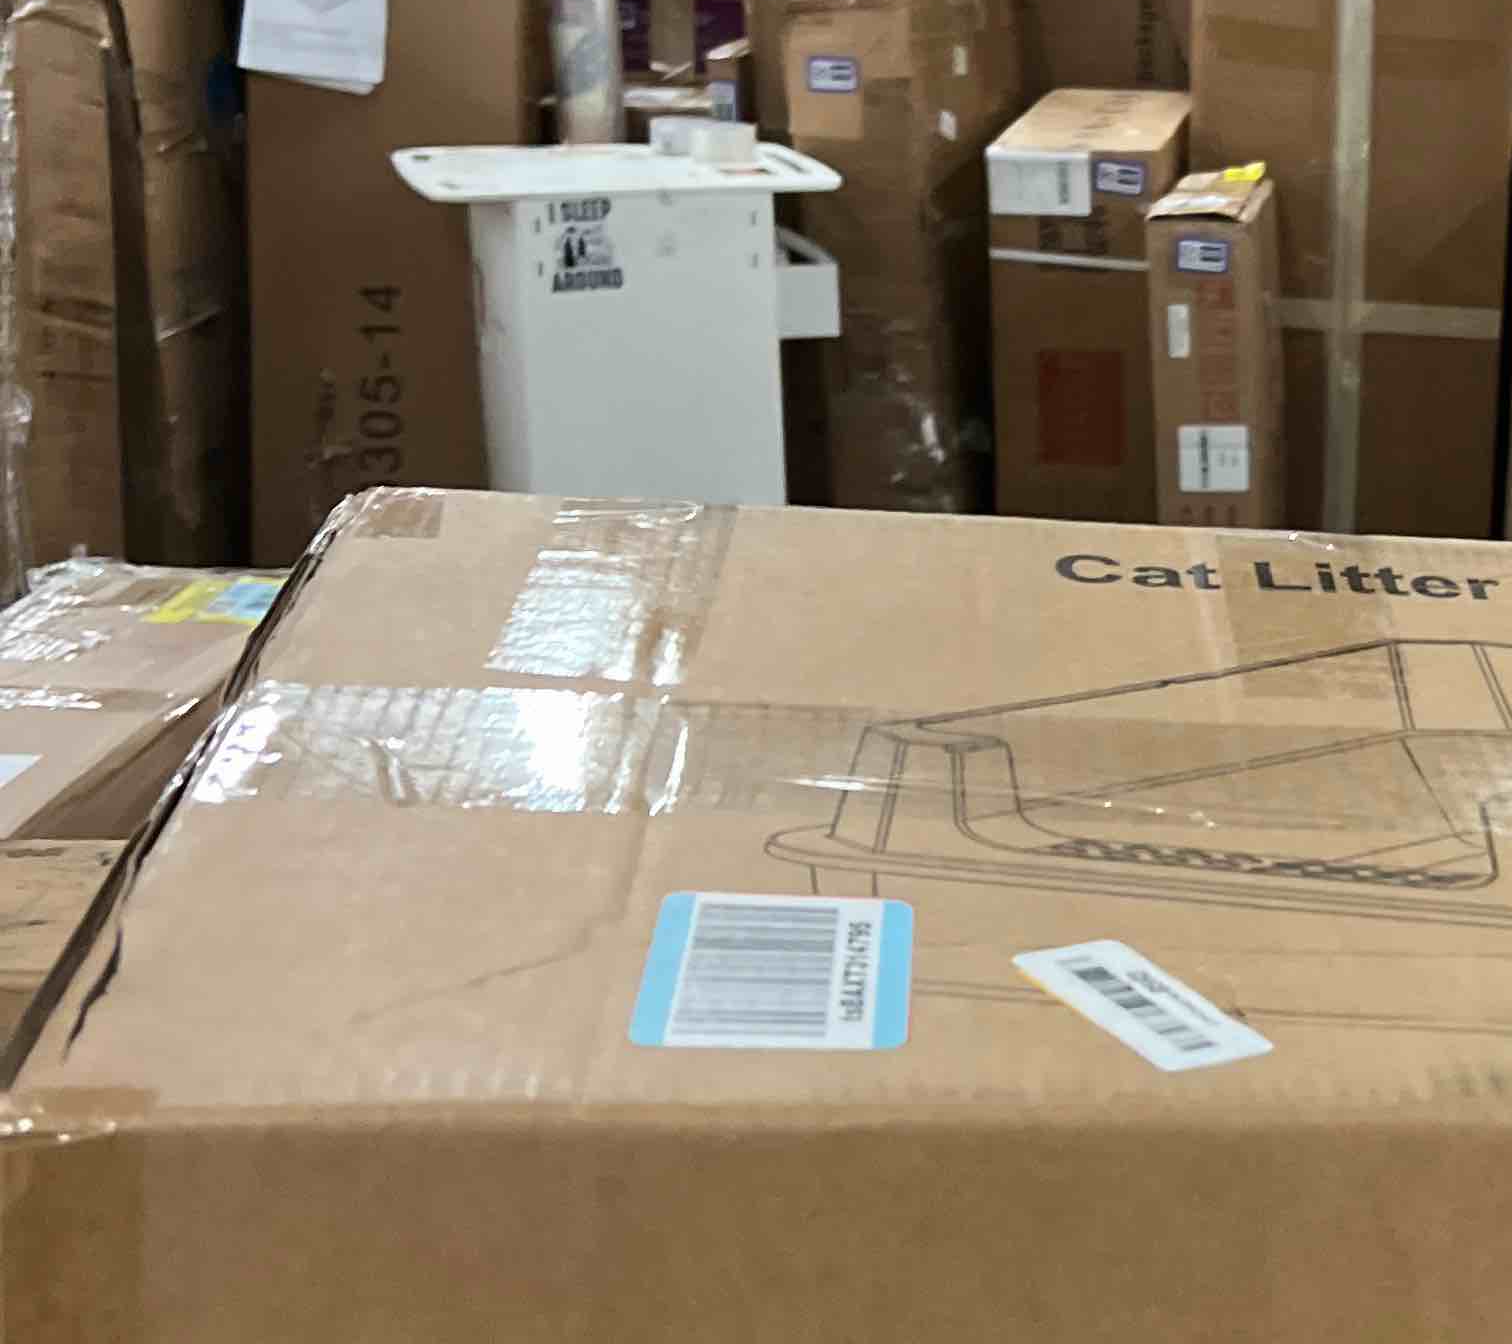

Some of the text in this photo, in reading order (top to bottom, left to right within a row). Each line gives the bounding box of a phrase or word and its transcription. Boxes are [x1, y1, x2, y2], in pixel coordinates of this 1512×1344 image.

[560, 197, 611, 223] SLEEP
[552, 268, 624, 293] AROUND
[1055, 554, 1222, 593] Cat
[1253, 562, 1504, 602] Litter
